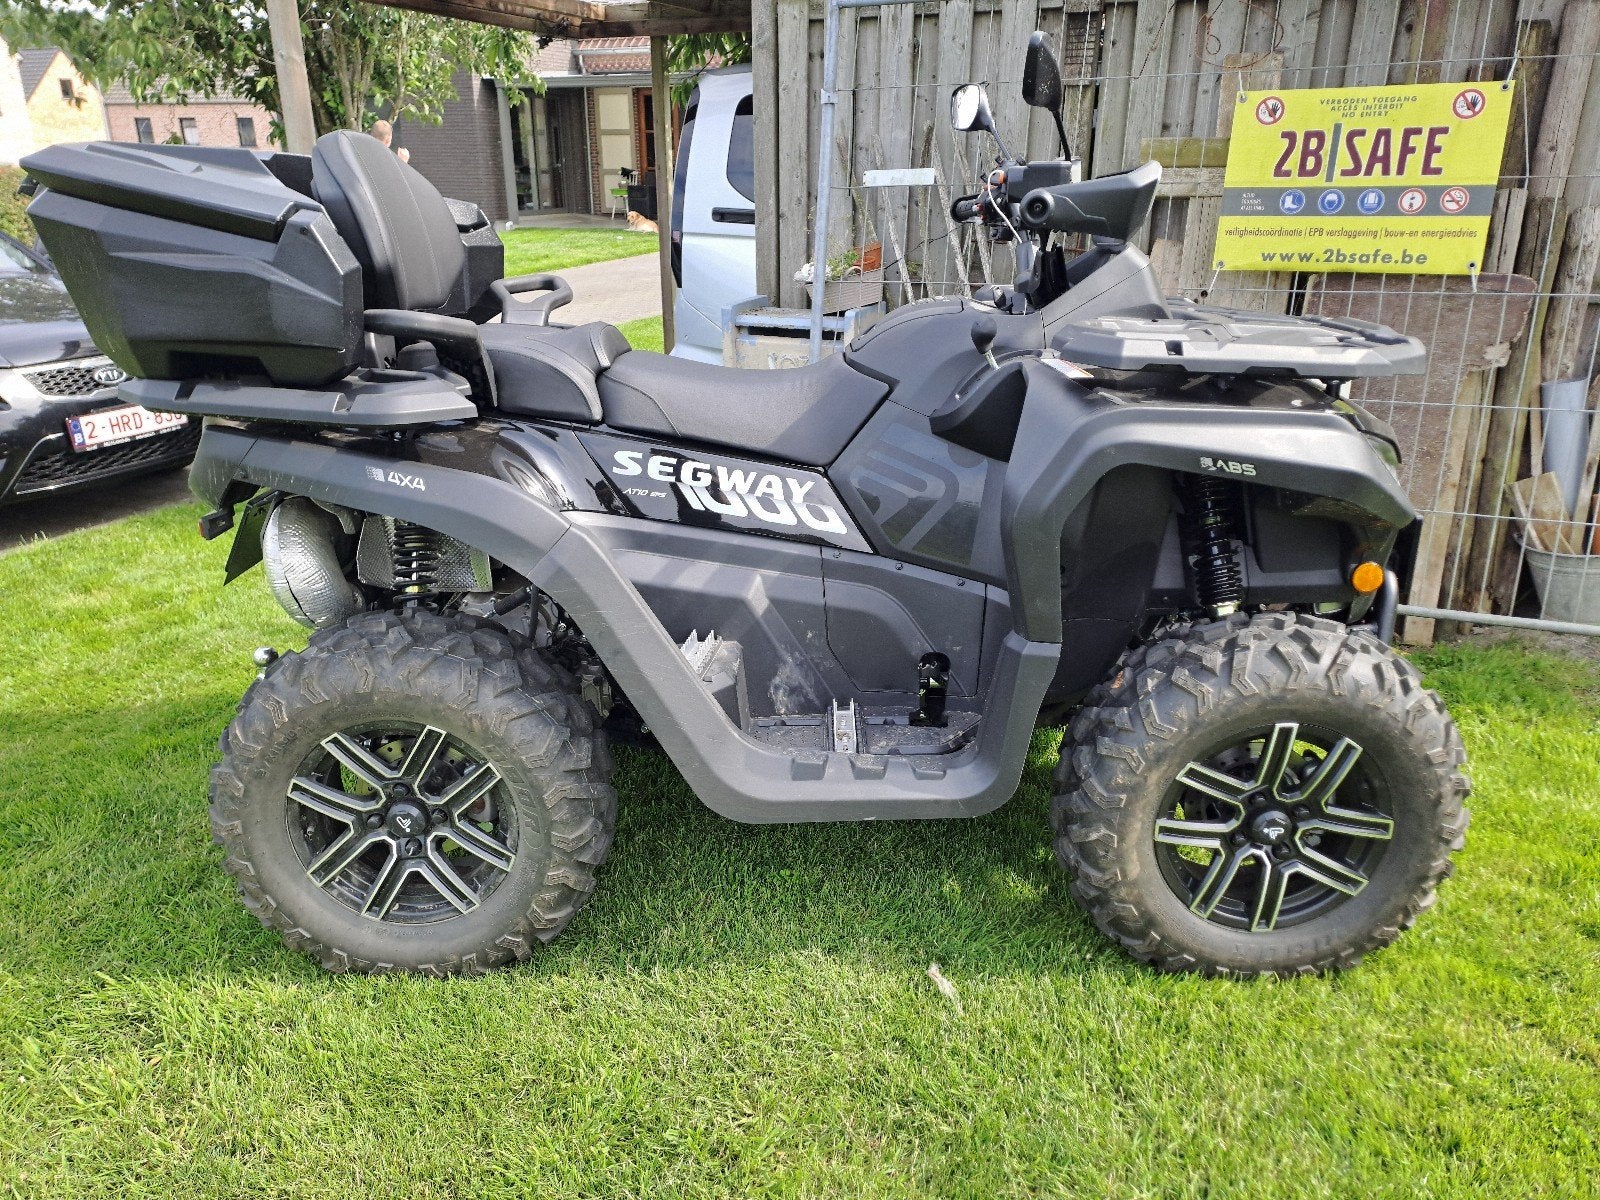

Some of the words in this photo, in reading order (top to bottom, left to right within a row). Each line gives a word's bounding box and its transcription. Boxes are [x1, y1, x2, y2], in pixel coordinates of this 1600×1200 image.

[1320, 97, 1367, 105] VERBODEN
[1373, 95, 1418, 103] TOEGANG
[1363, 102, 1404, 110] INTERDIT
[1360, 110, 1389, 118] ENTRY
[1308, 227, 1324, 236] EPB
[1326, 227, 1378, 239] verslaggeving
[1421, 228, 1478, 239] energieadvies
[1261, 248, 1428, 265] www.2bsafe.be
[1216, 459, 1257, 476] ABS
[612, 450, 815, 503] SEGWAY
